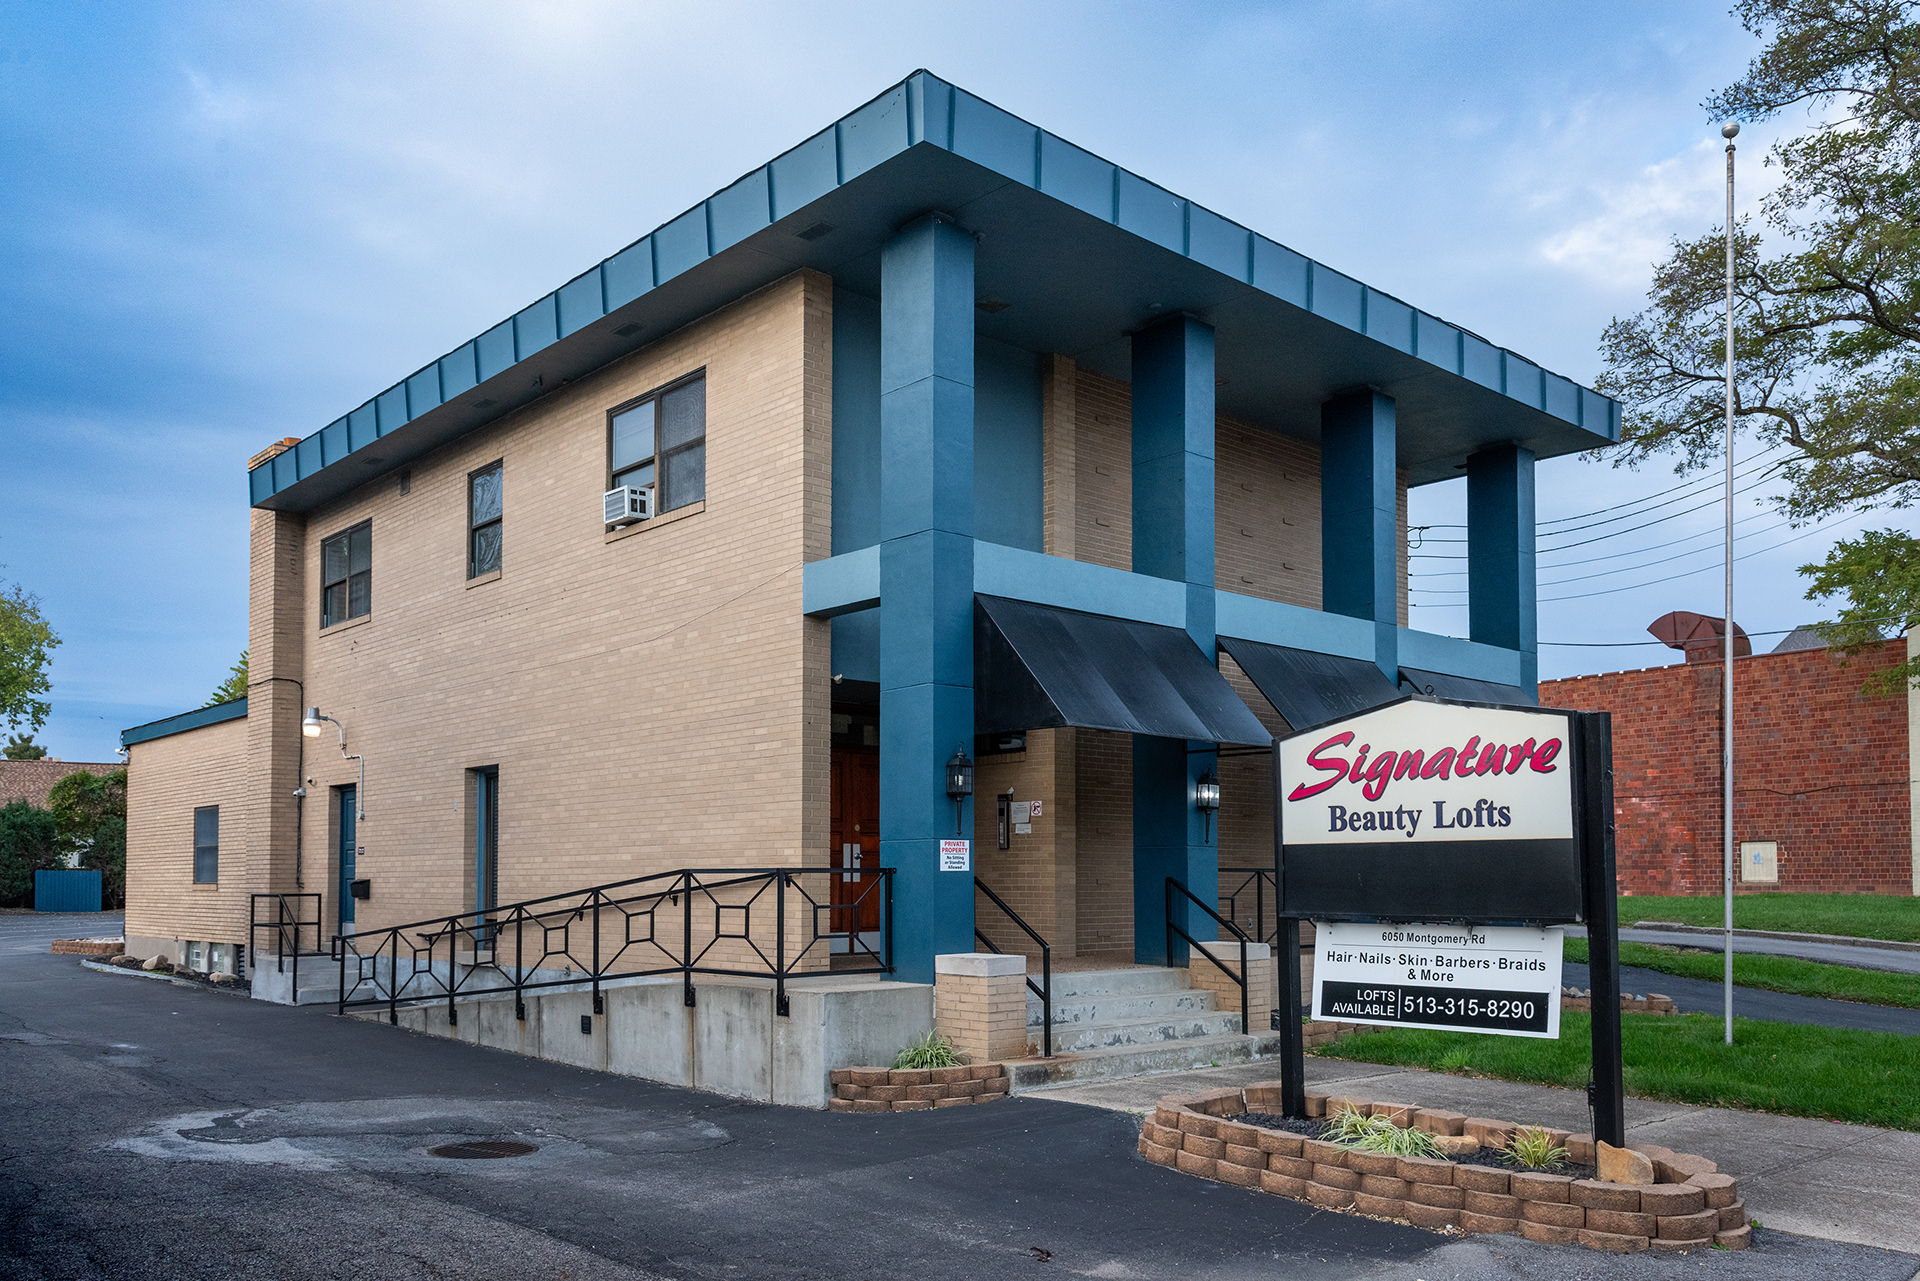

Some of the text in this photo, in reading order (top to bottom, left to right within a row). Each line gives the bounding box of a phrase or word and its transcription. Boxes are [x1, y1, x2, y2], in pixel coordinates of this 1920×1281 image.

[1287, 731, 1562, 801] Signature
[1328, 799, 1511, 837] Beauty Lofts
[1381, 931, 1486, 946] 6050 Montgomery Rd
[1327, 950, 1546, 972] Hair Nails Skin Barbers Braids
[1407, 968, 1454, 982] & More
[1357, 989, 1396, 1002] LOFTS
[1331, 1002, 1395, 1016] AVAILABLE
[1403, 995, 1535, 1019] 513-315-8290
